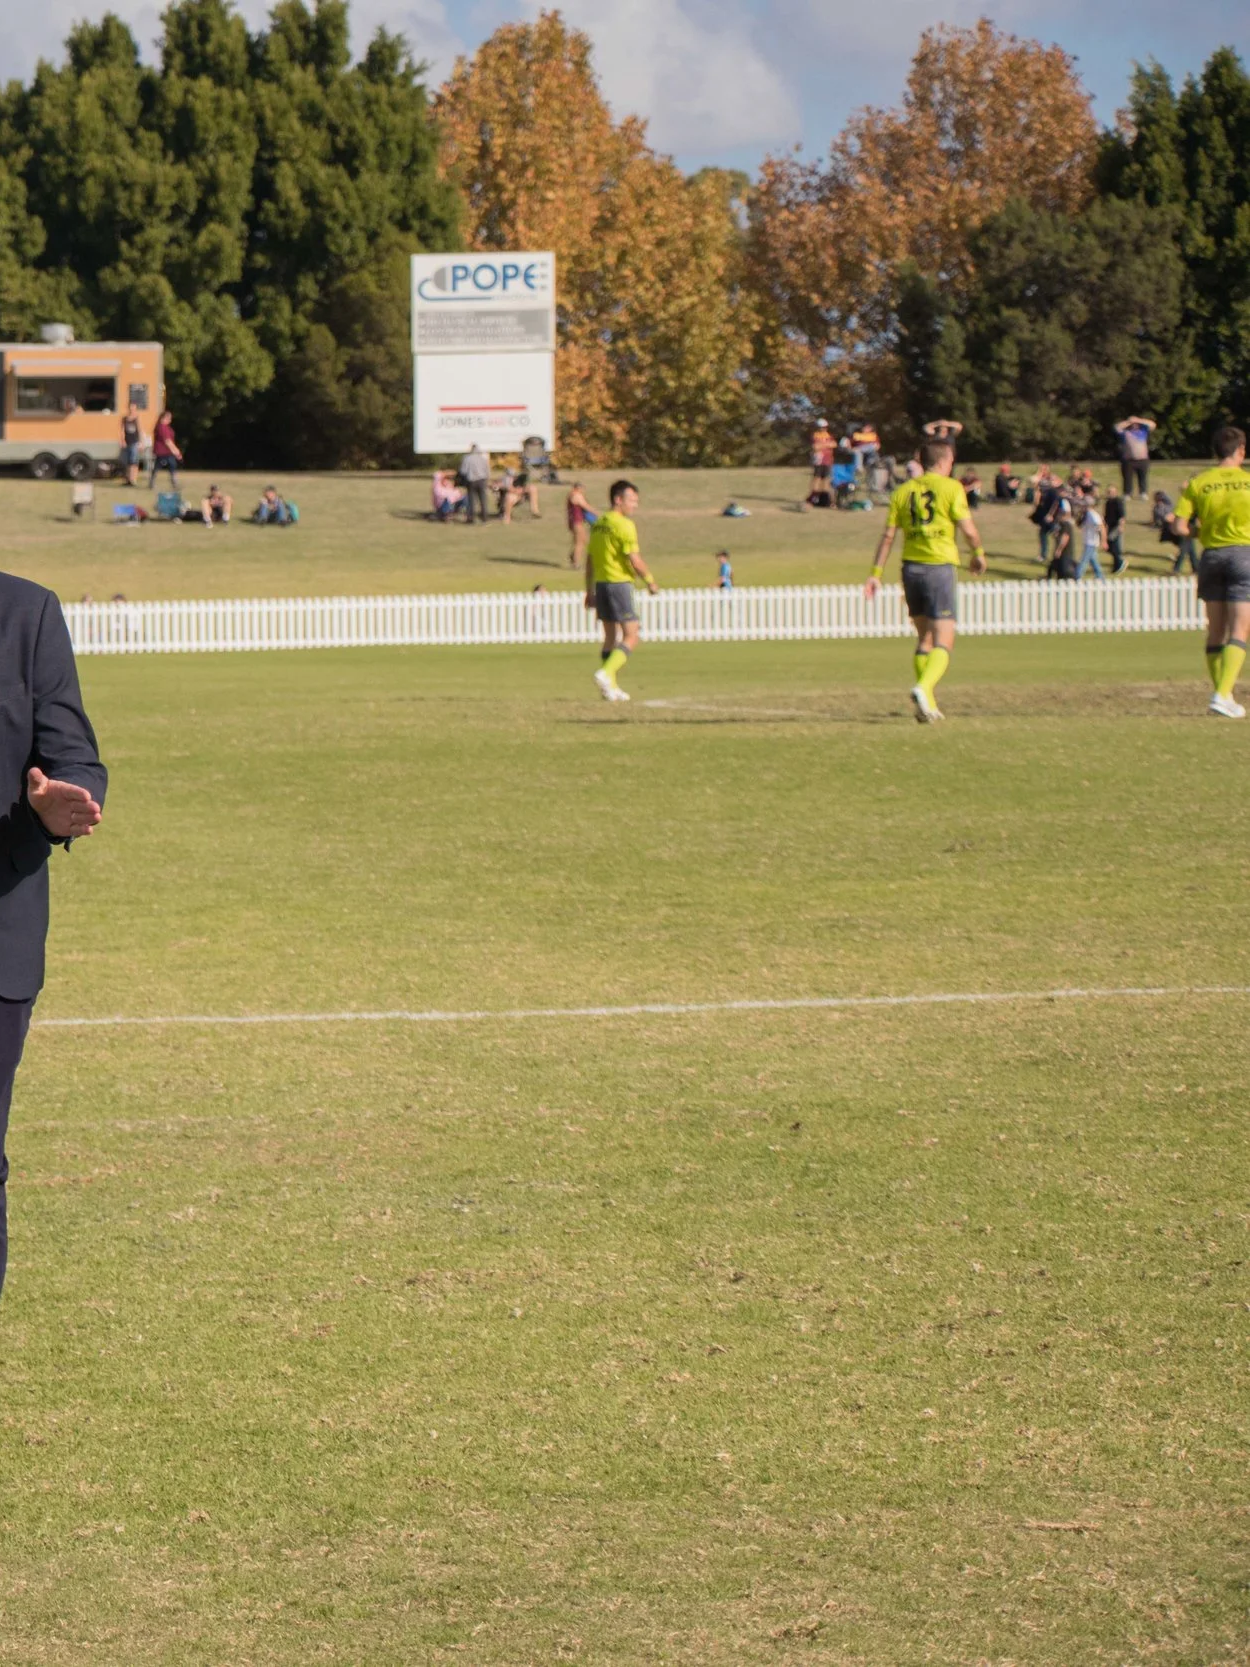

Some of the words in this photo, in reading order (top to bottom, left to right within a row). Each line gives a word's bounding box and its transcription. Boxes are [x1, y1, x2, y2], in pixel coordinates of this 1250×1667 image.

[451, 264, 538, 291] POPE
[437, 415, 485, 428] JONES
[509, 414, 531, 427] CO
[1202, 481, 1250, 494] OPTUS
[910, 489, 936, 526] 13
